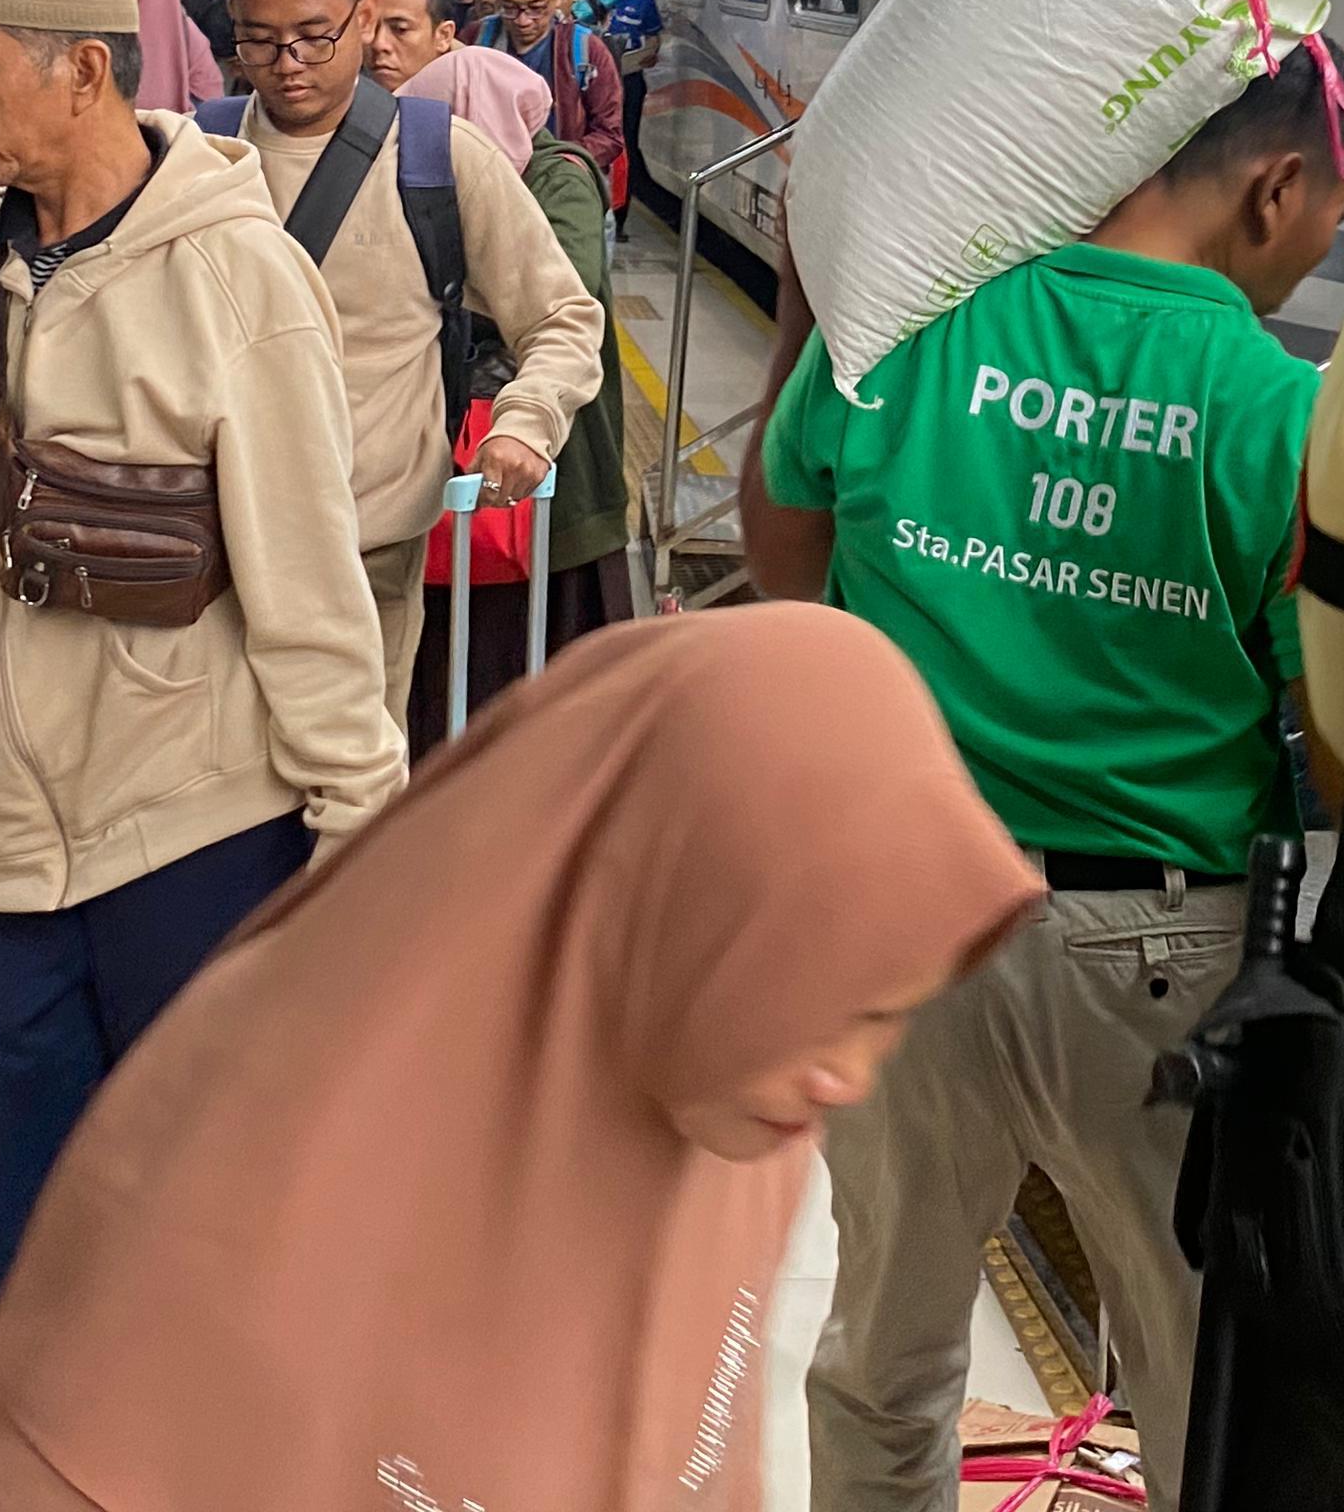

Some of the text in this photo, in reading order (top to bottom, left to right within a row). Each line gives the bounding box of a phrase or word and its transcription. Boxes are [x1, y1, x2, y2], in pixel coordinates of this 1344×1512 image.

[968, 364, 1199, 459] PORTER
[1028, 472, 1117, 536] 108
[1086, 568, 1211, 621] SENEN
